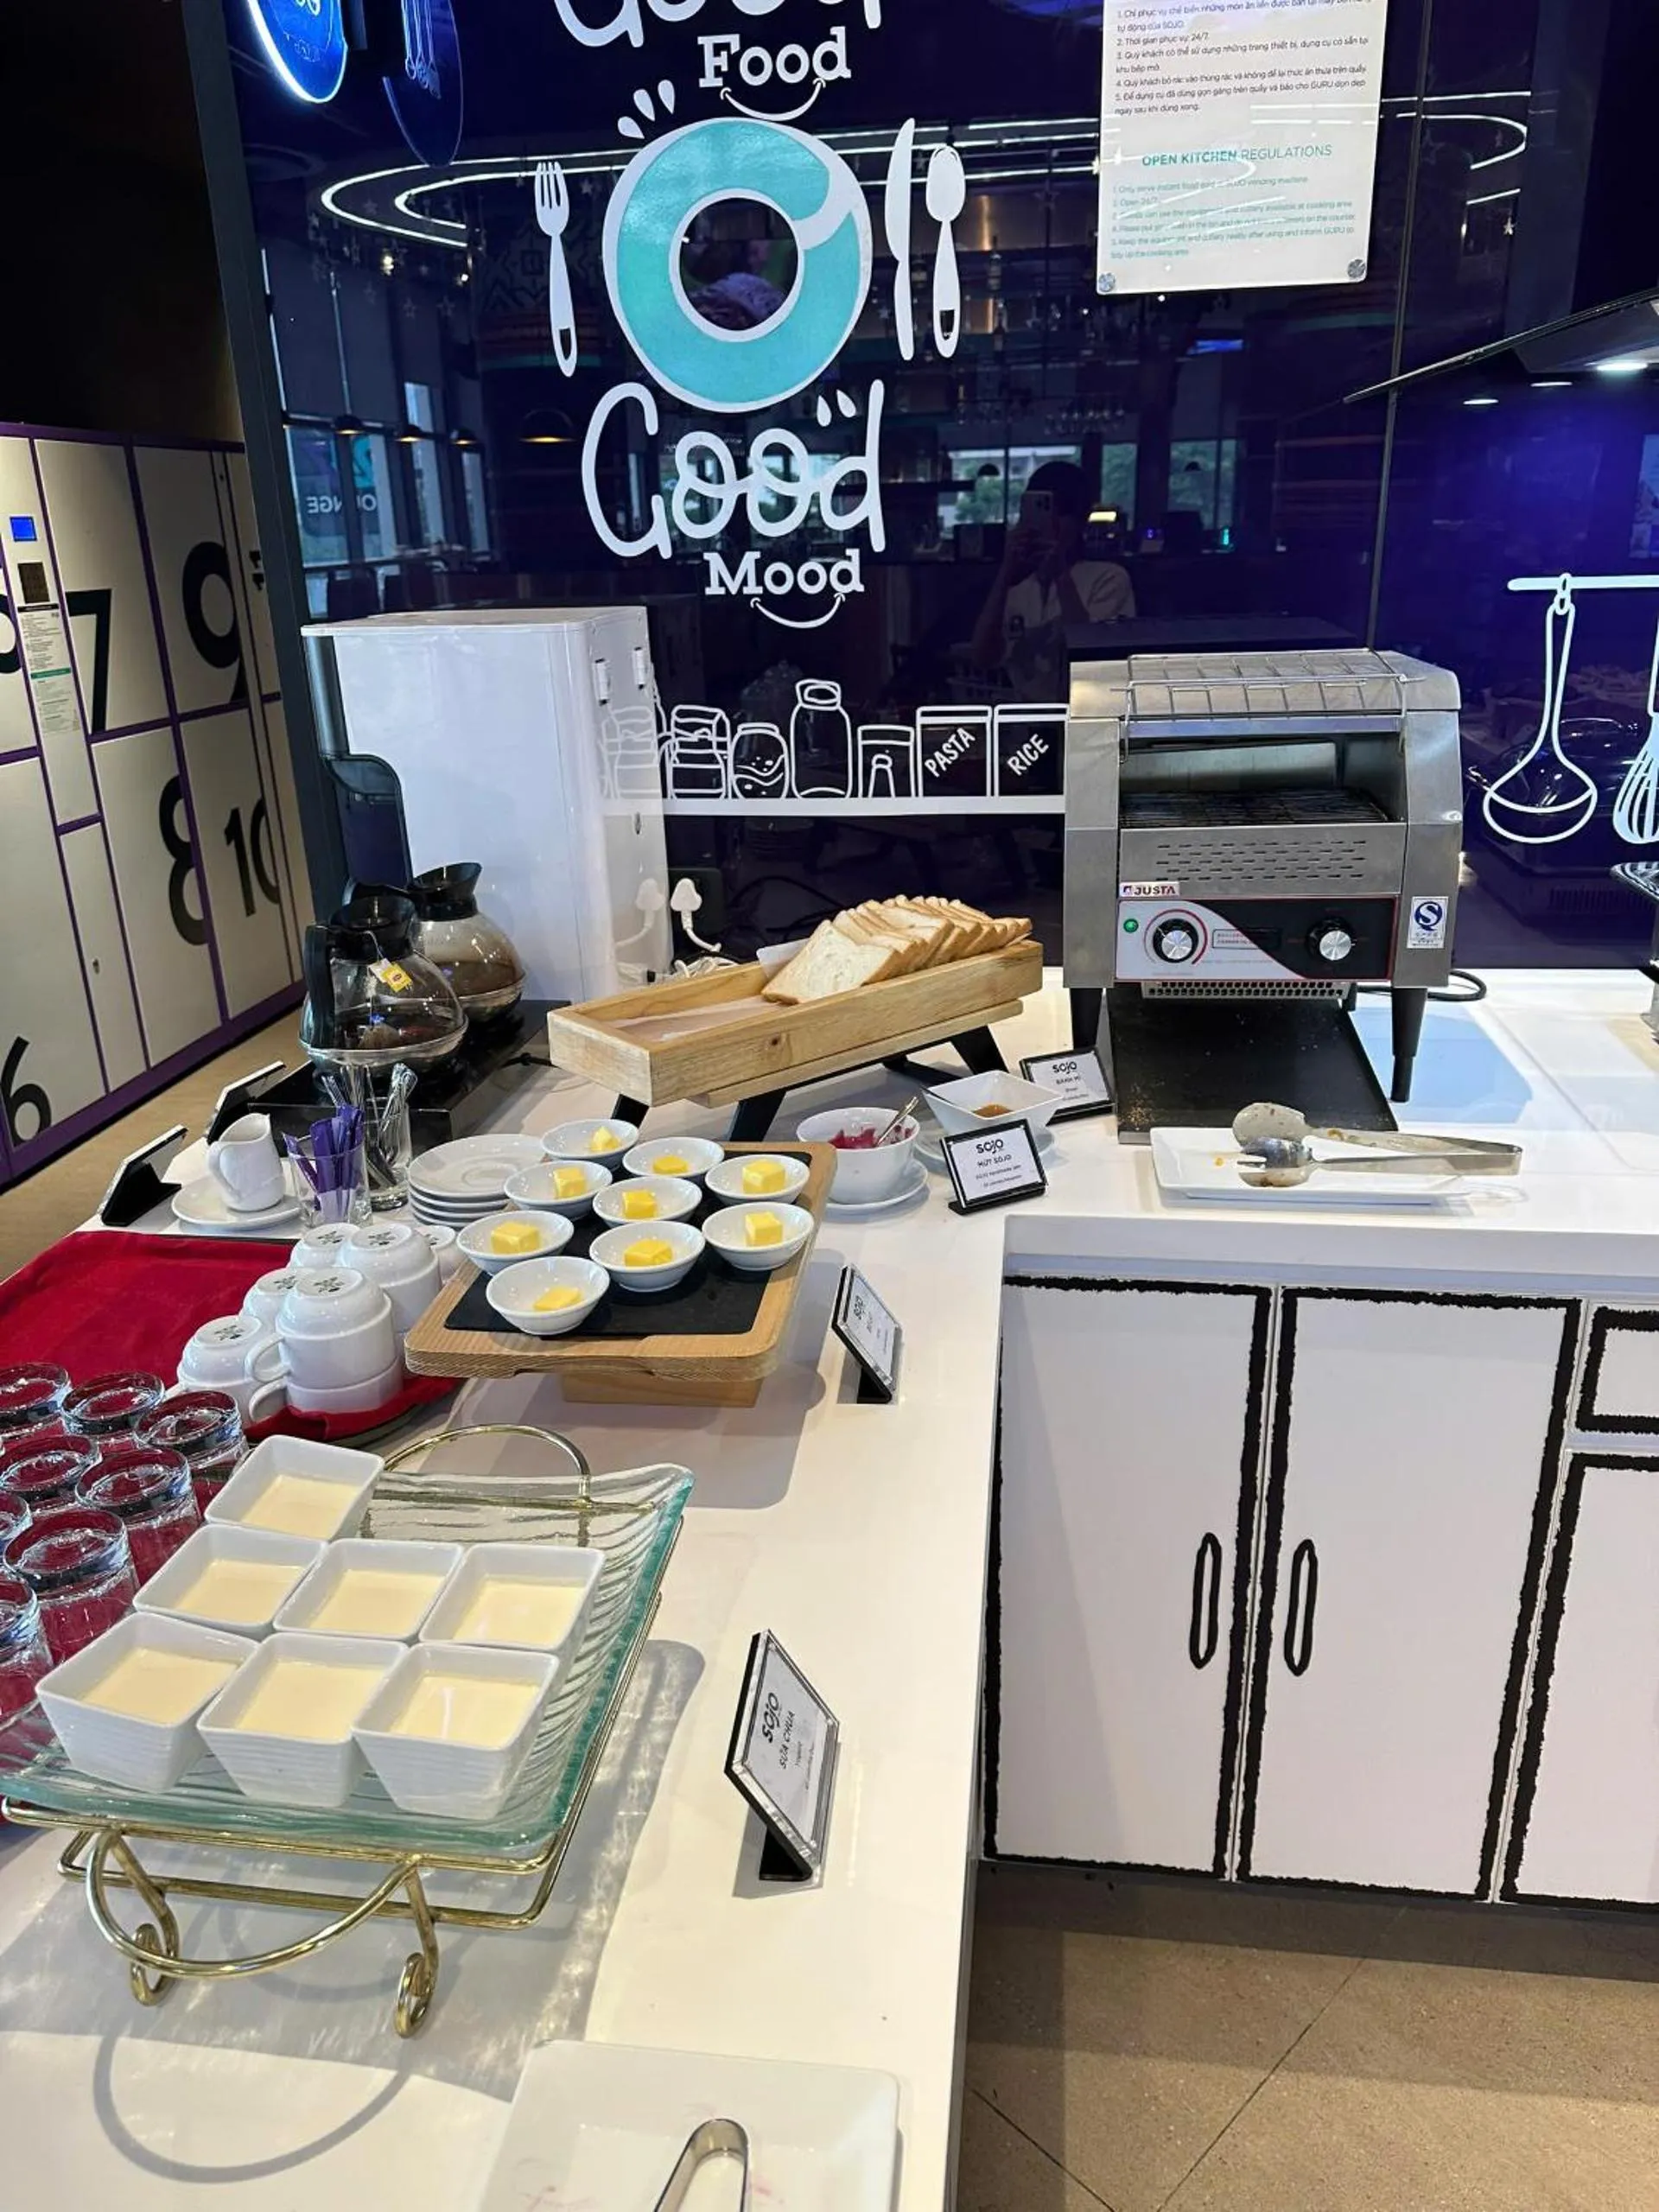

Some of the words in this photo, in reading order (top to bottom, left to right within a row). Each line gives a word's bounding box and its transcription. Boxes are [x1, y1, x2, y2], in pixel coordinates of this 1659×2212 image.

[698, 27, 852, 88] Food
[1142, 155, 1178, 166] OPEN
[1181, 149, 1237, 163] KITCHEN
[1242, 144, 1332, 160] REGULATIONS
[582, 379, 886, 559] Good
[704, 548, 865, 596] Mood
[182, 541, 247, 702] 9
[65, 589, 111, 734] 7
[924, 727, 976, 778] PASTA
[1007, 734, 1049, 777] RICE
[1134, 885, 1176, 896] JUSTA
[1, 1036, 52, 1147] 6
